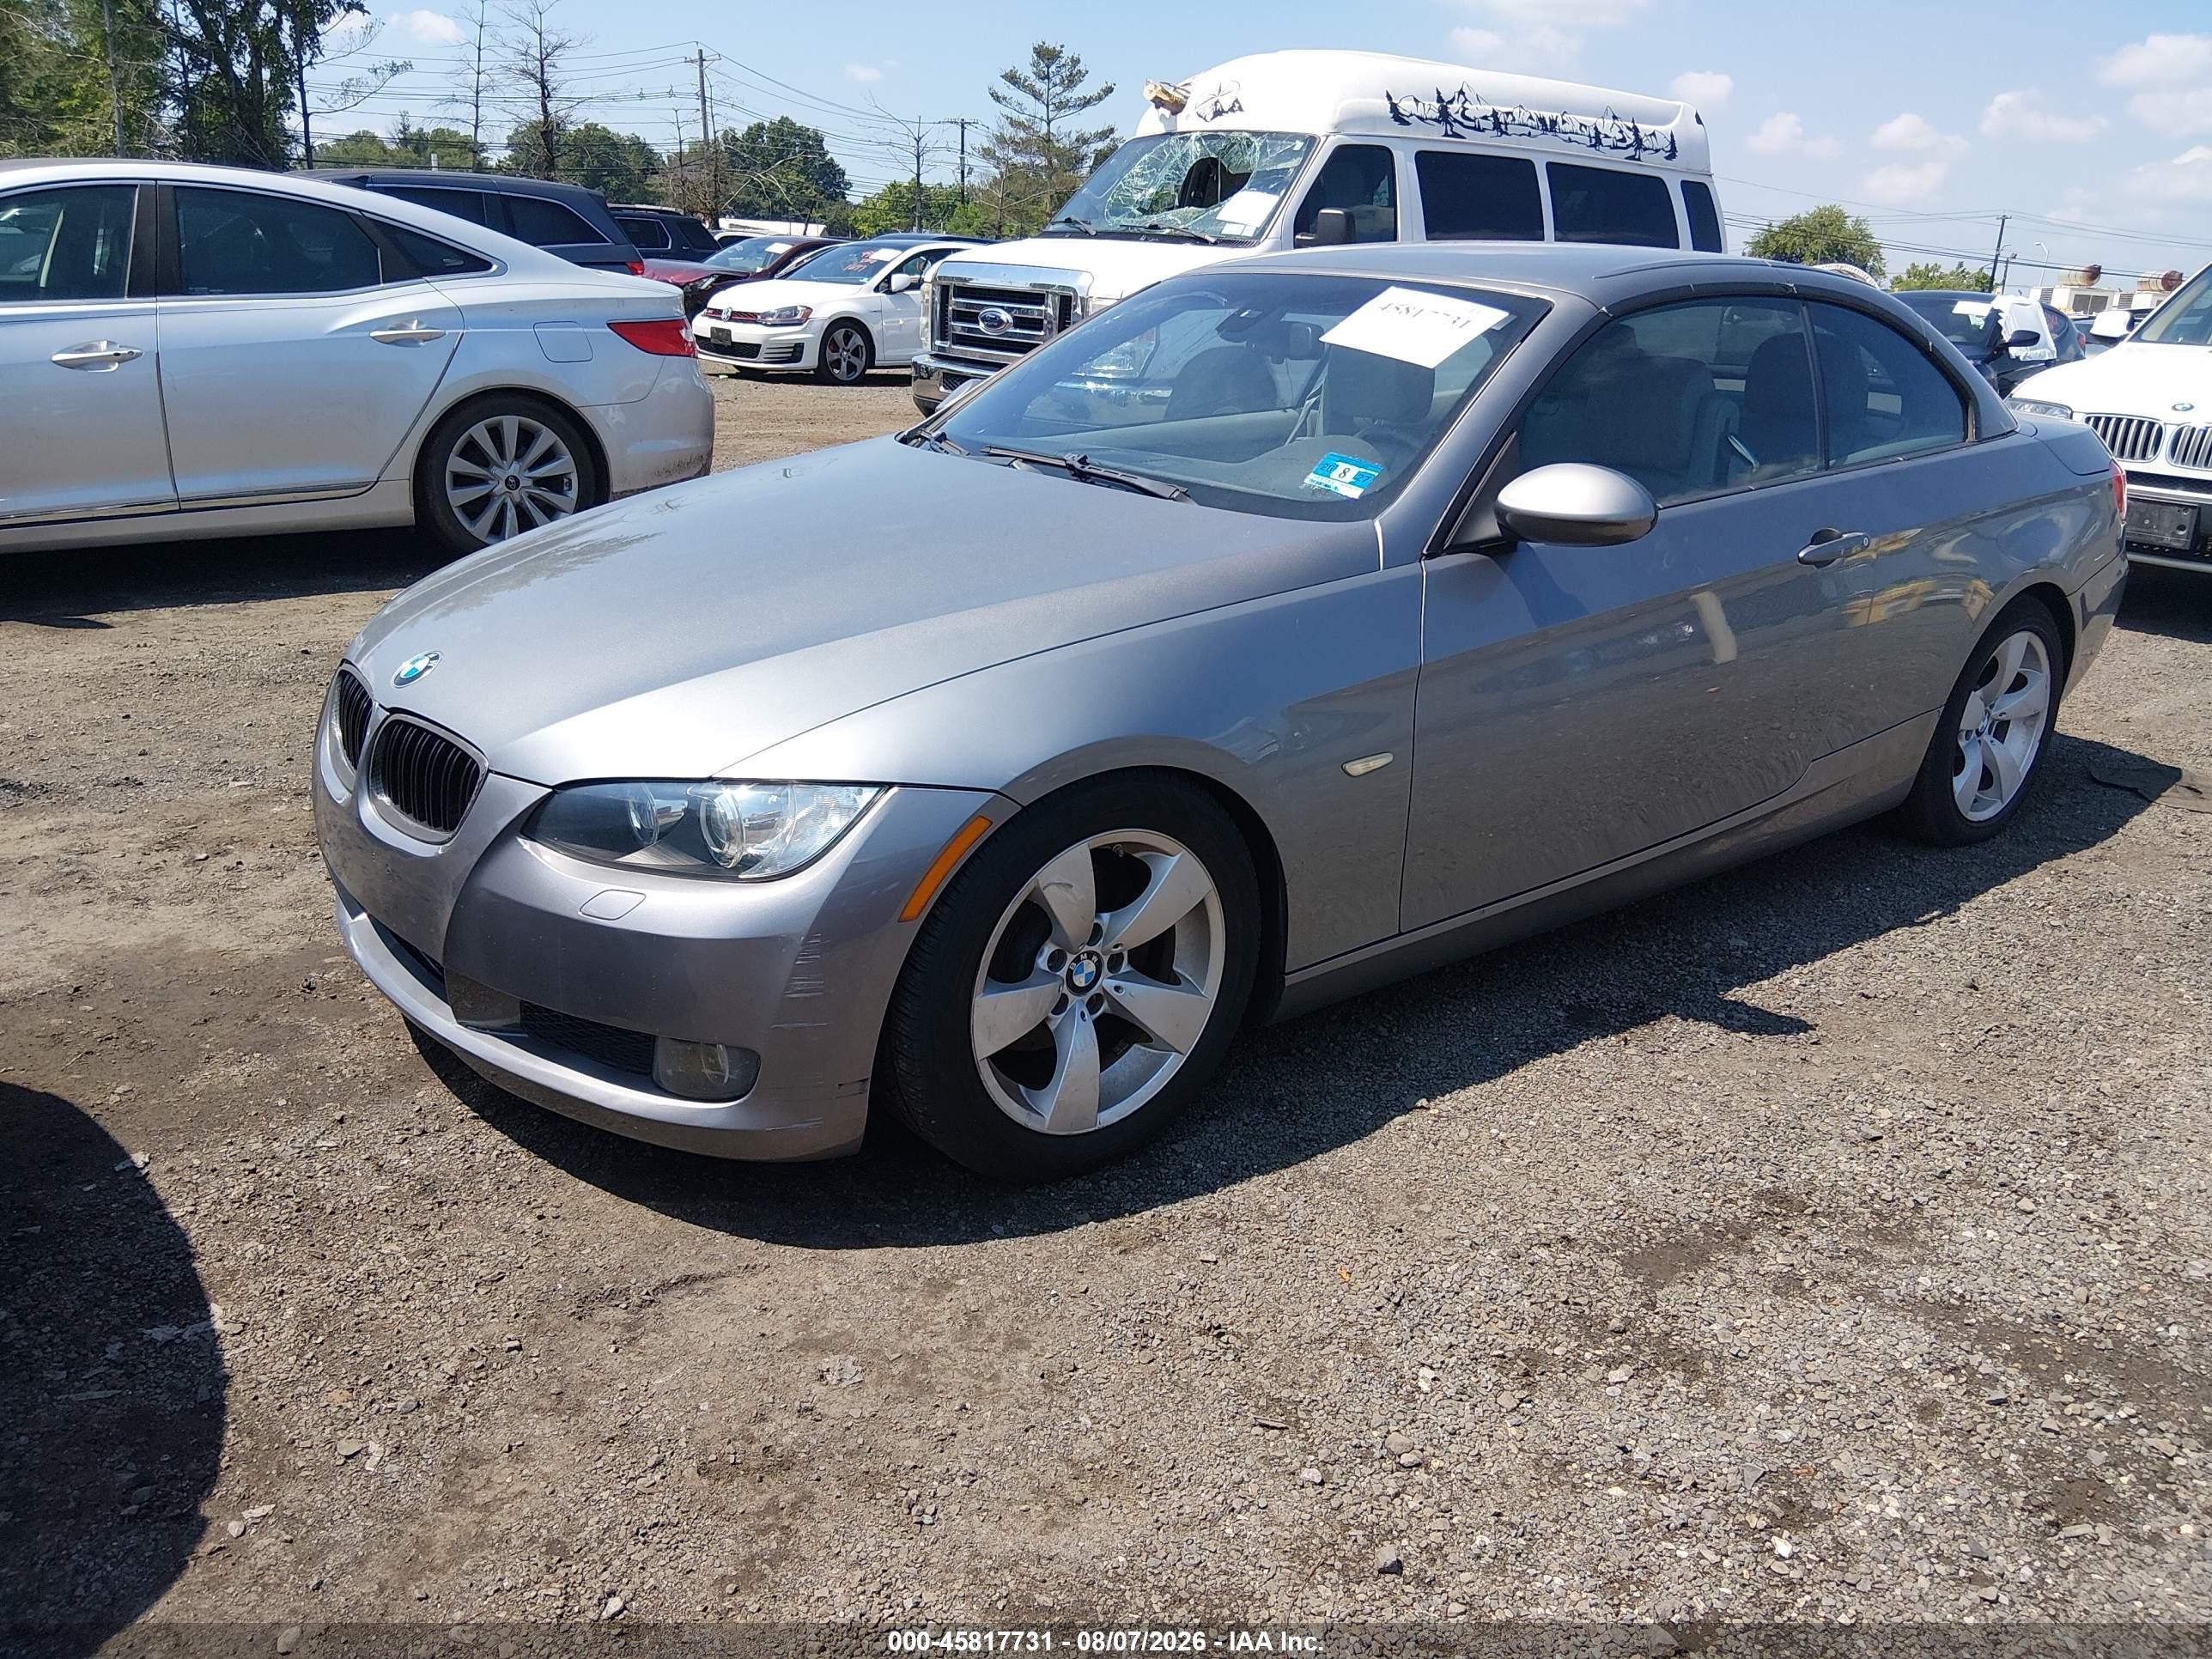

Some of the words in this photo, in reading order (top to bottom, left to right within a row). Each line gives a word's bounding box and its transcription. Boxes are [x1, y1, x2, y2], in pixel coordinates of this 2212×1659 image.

[1338, 467, 1351, 478] 8
[1357, 473, 1371, 483] 27
[1069, 952, 1099, 970] BMW
